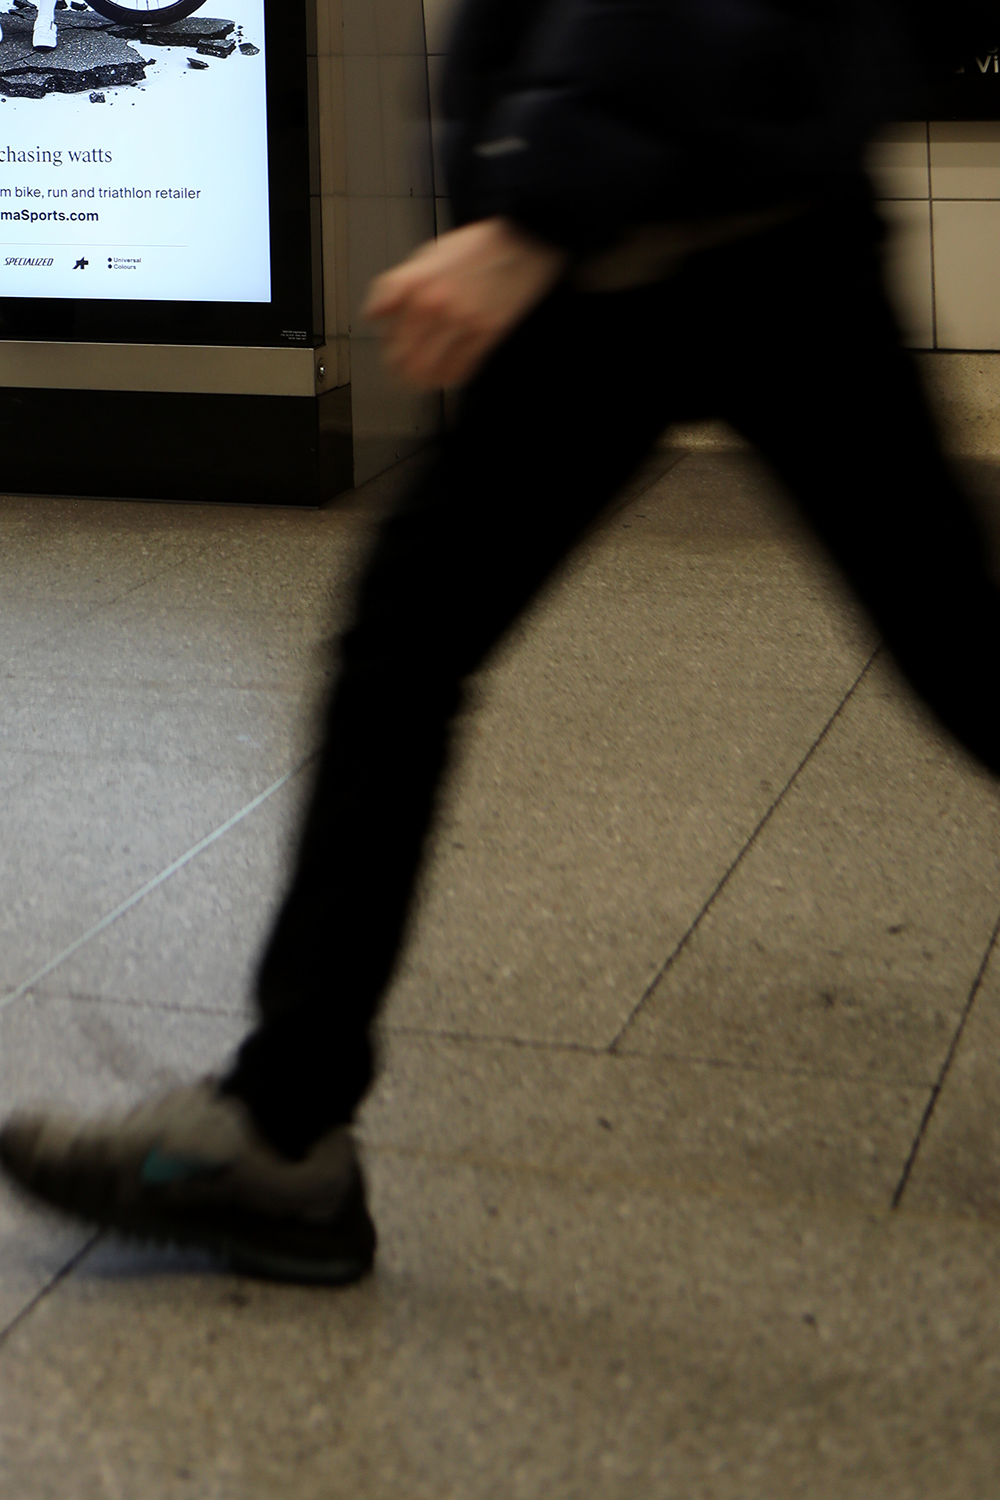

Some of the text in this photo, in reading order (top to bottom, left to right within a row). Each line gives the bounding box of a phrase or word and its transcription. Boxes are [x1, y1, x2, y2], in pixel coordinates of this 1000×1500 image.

[68, 148, 113, 163] watts
[14, 186, 45, 200] bike,
[47, 188, 68, 198] run
[71, 187, 96, 198] and
[98, 187, 152, 199] triathlon
[155, 187, 202, 199] retailer
[3, 256, 55, 267] SPECIALIZED
